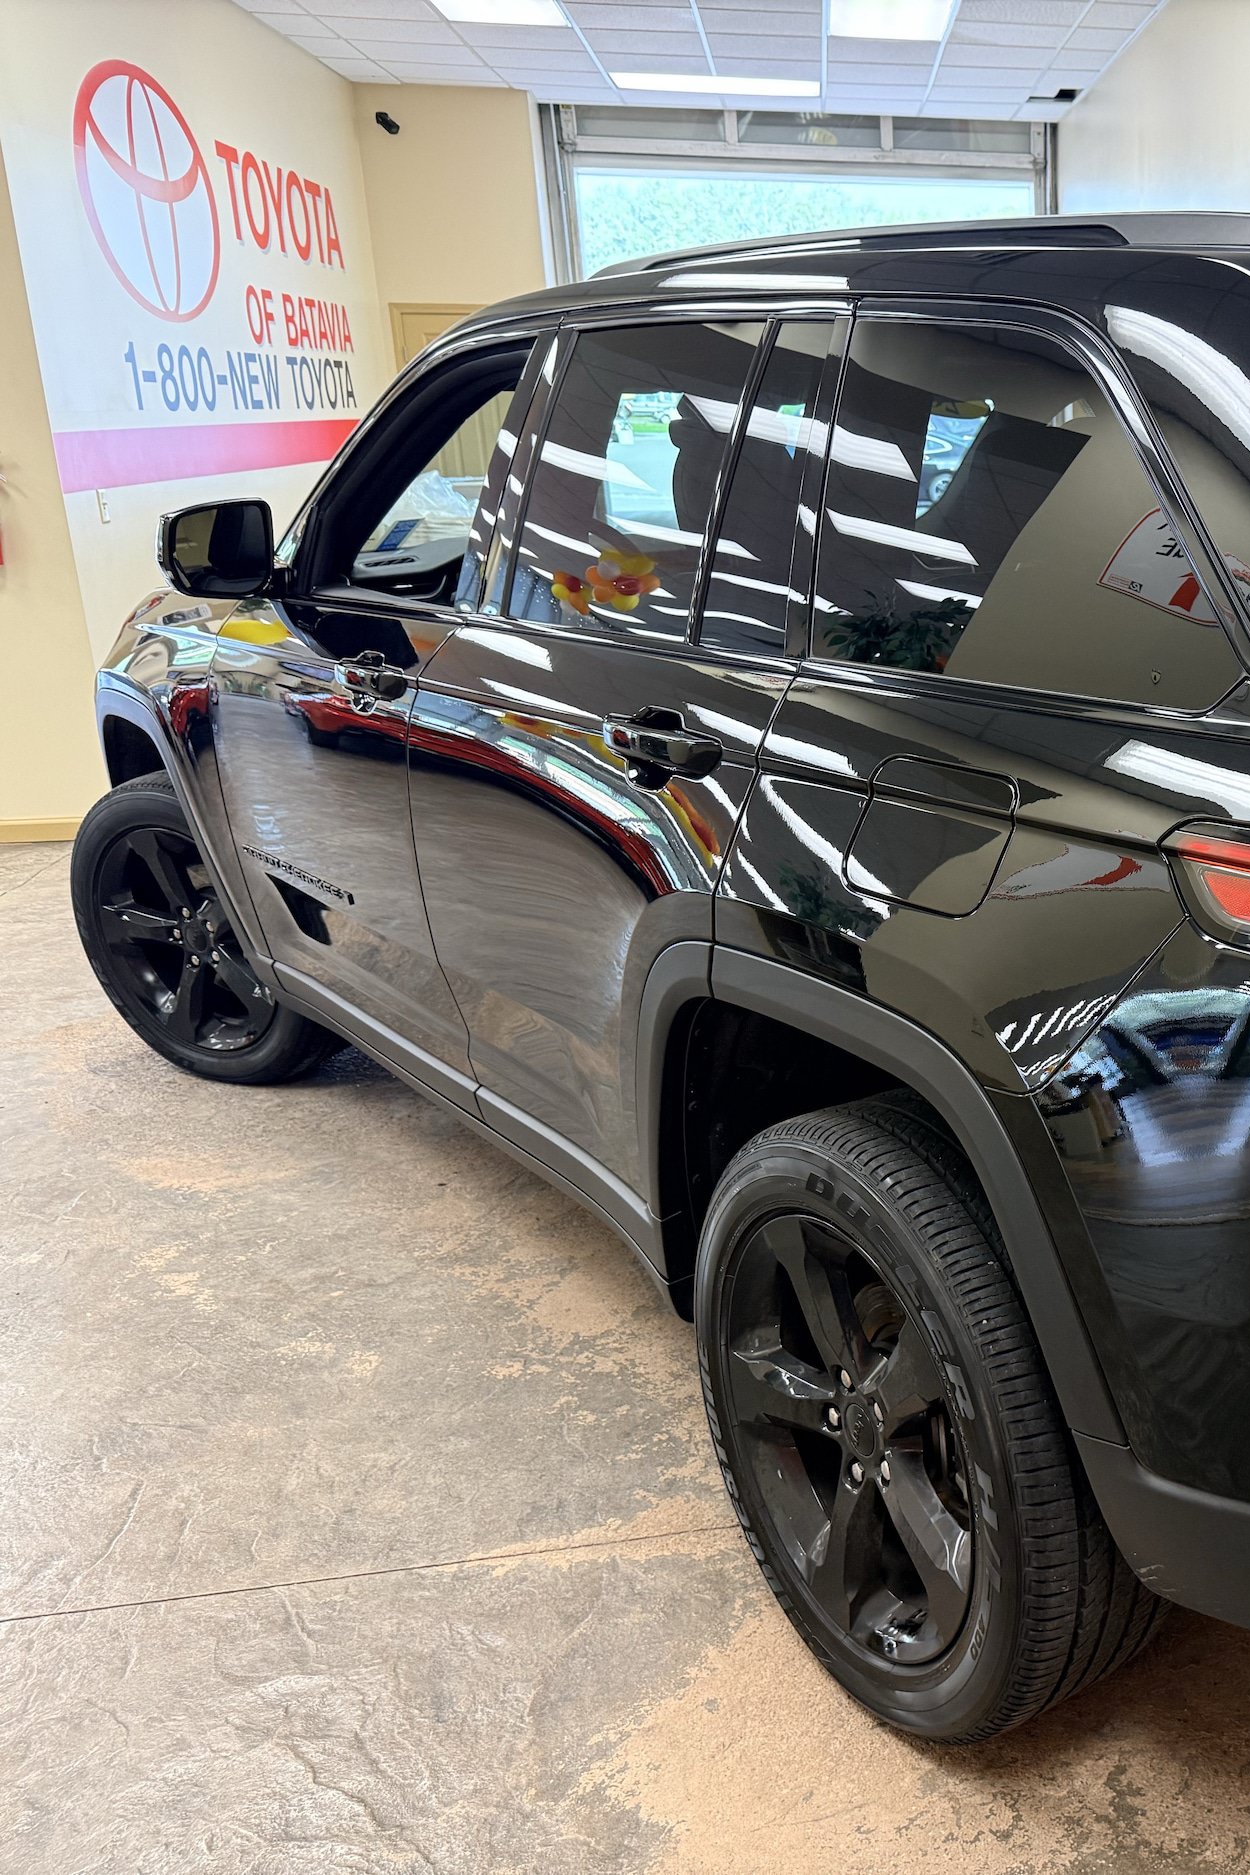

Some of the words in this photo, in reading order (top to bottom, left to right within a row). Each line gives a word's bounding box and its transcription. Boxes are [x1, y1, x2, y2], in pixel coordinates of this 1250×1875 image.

[214, 140, 345, 270] TOYOTA
[246, 285, 274, 344] OF
[282, 293, 354, 353] BATAVIA
[124, 341, 280, 412] 1-800-NEW
[286, 355, 357, 409] TOYOTA
[805, 1172, 976, 1421] DUELER
